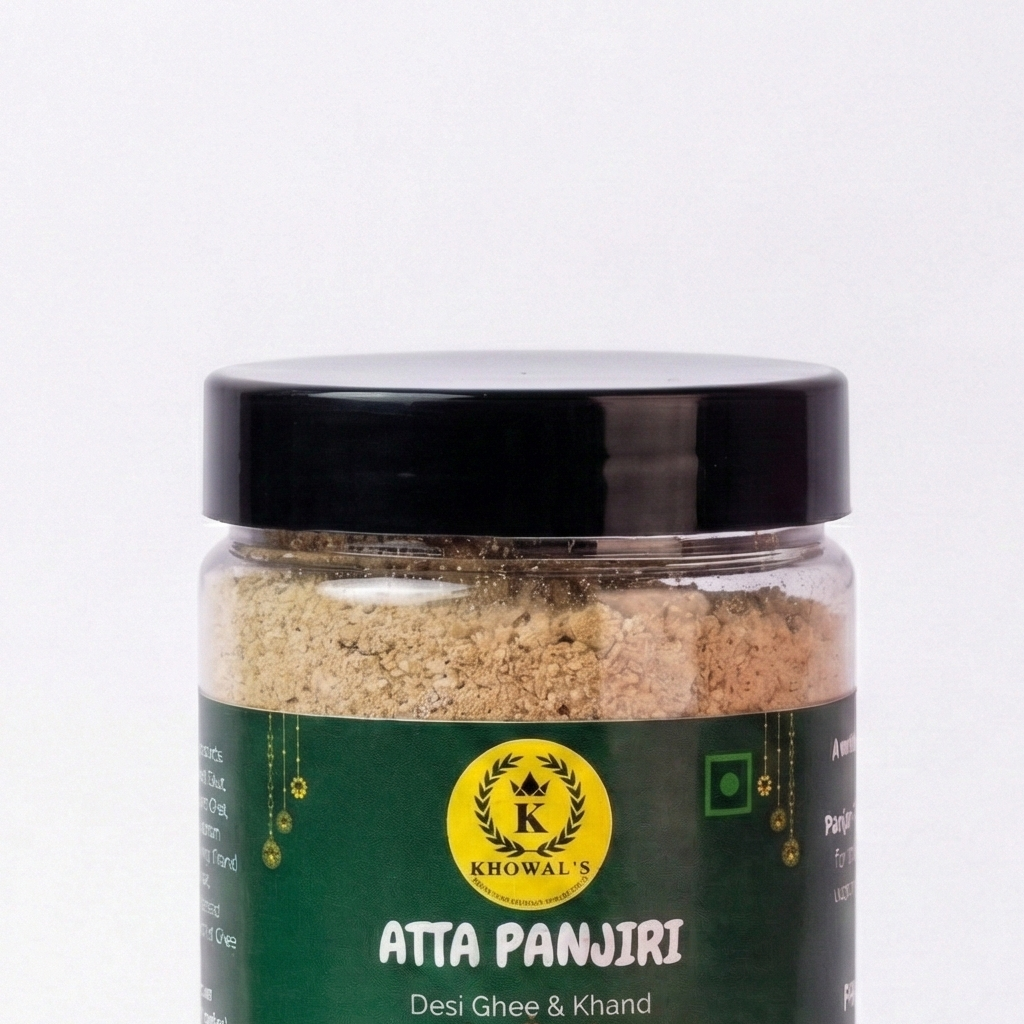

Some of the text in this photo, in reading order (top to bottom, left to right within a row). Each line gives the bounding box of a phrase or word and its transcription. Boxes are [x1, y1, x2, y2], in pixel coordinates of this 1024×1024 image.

[514, 803, 549, 833] K
[470, 861, 590, 876] KHOWAL'S
[379, 919, 684, 968] ATTA PANJIRI
[410, 993, 651, 1017] Desi Ghee & Khand
